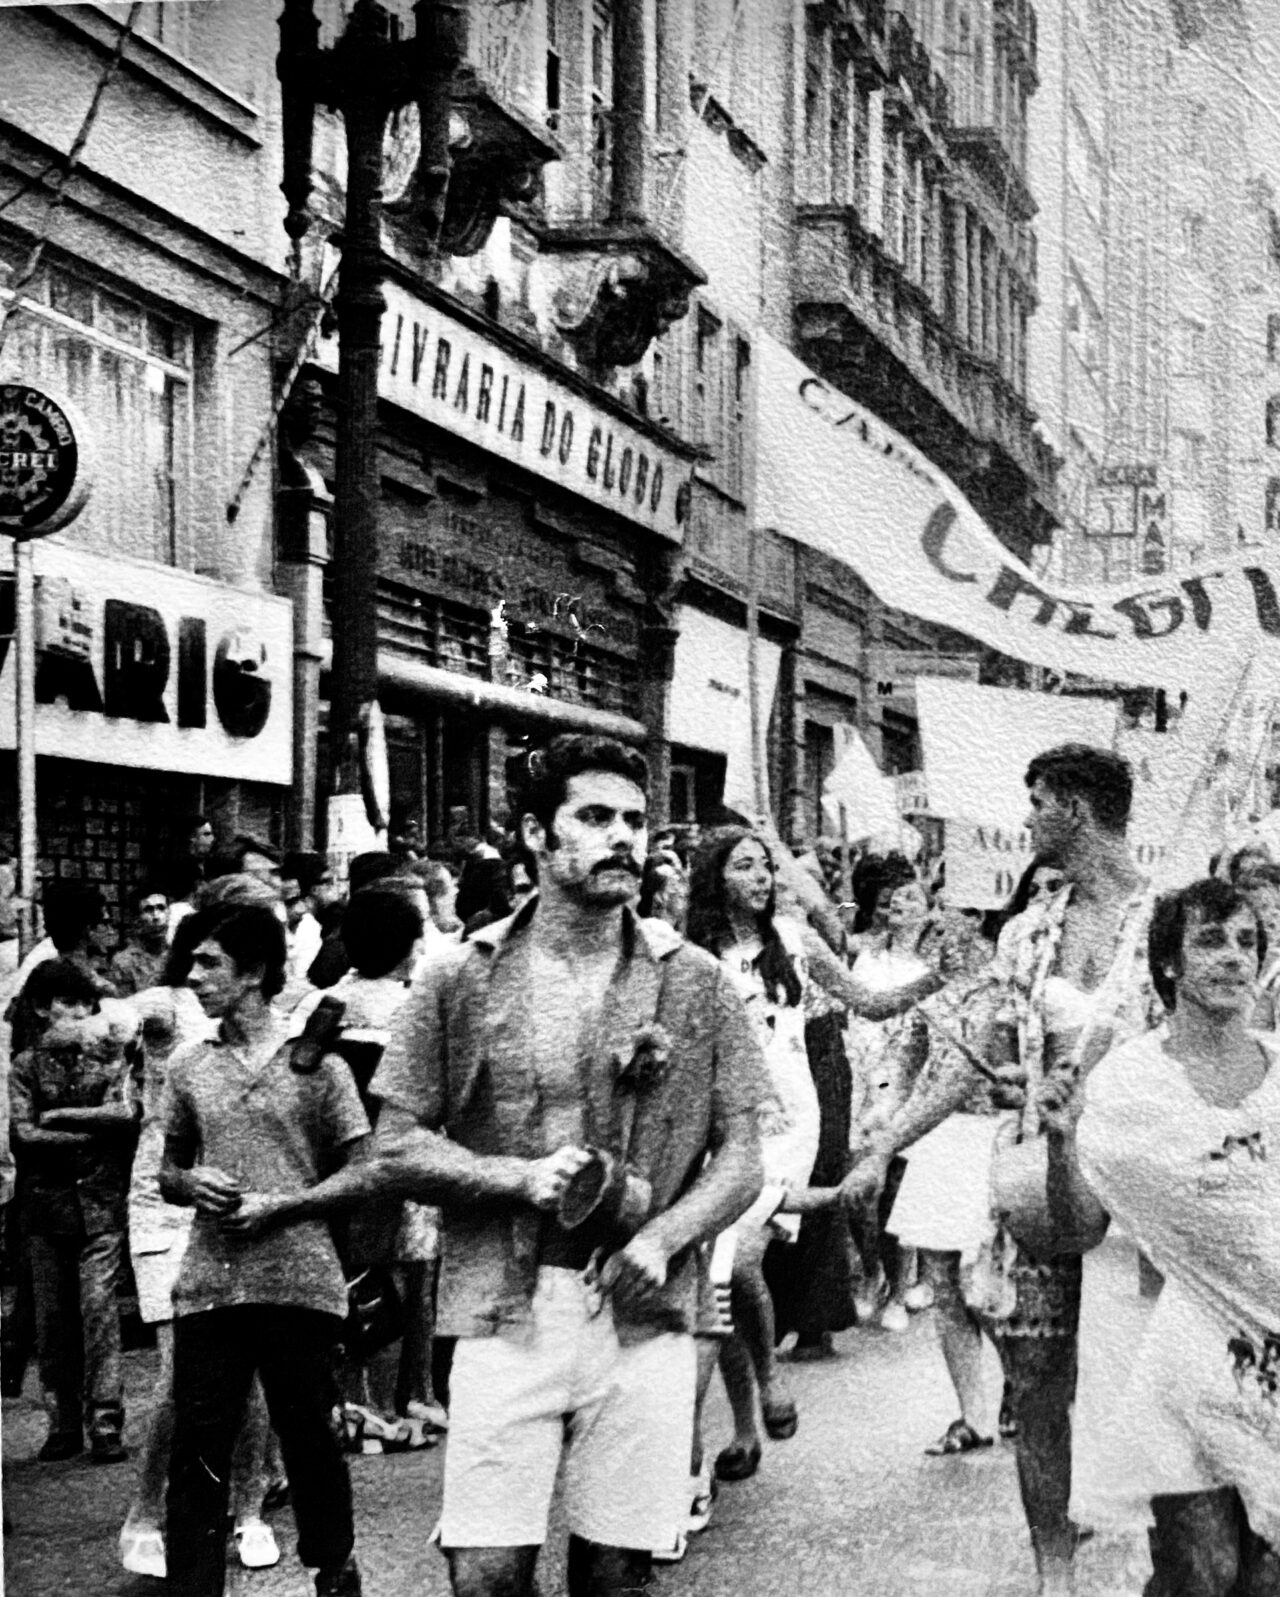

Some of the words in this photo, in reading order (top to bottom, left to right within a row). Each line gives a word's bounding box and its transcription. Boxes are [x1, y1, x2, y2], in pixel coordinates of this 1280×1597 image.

[390, 313, 525, 442] IVRARIA
[540, 400, 573, 465] DO
[587, 426, 664, 513] GLOBO
[32, 574, 272, 739] ARIG
